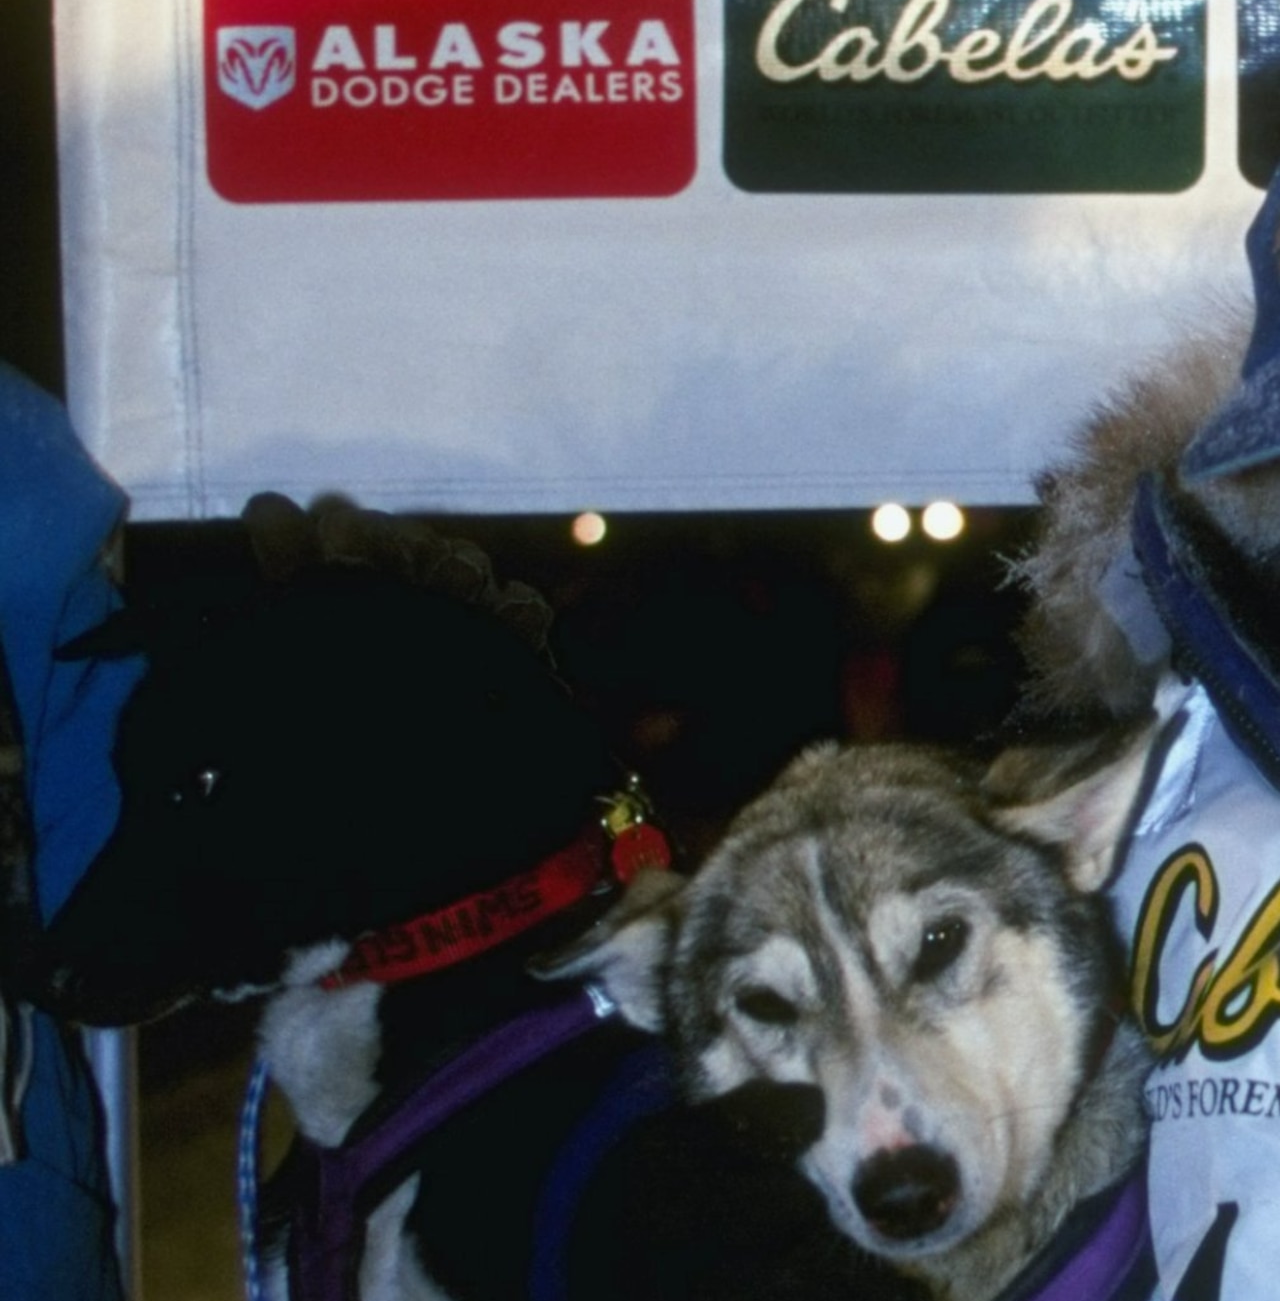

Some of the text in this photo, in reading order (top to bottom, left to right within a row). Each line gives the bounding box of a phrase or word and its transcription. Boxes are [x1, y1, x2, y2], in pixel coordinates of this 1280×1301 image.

[312, 20, 682, 71] ALASKA
[312, 71, 684, 108] DODGE DEALERS
